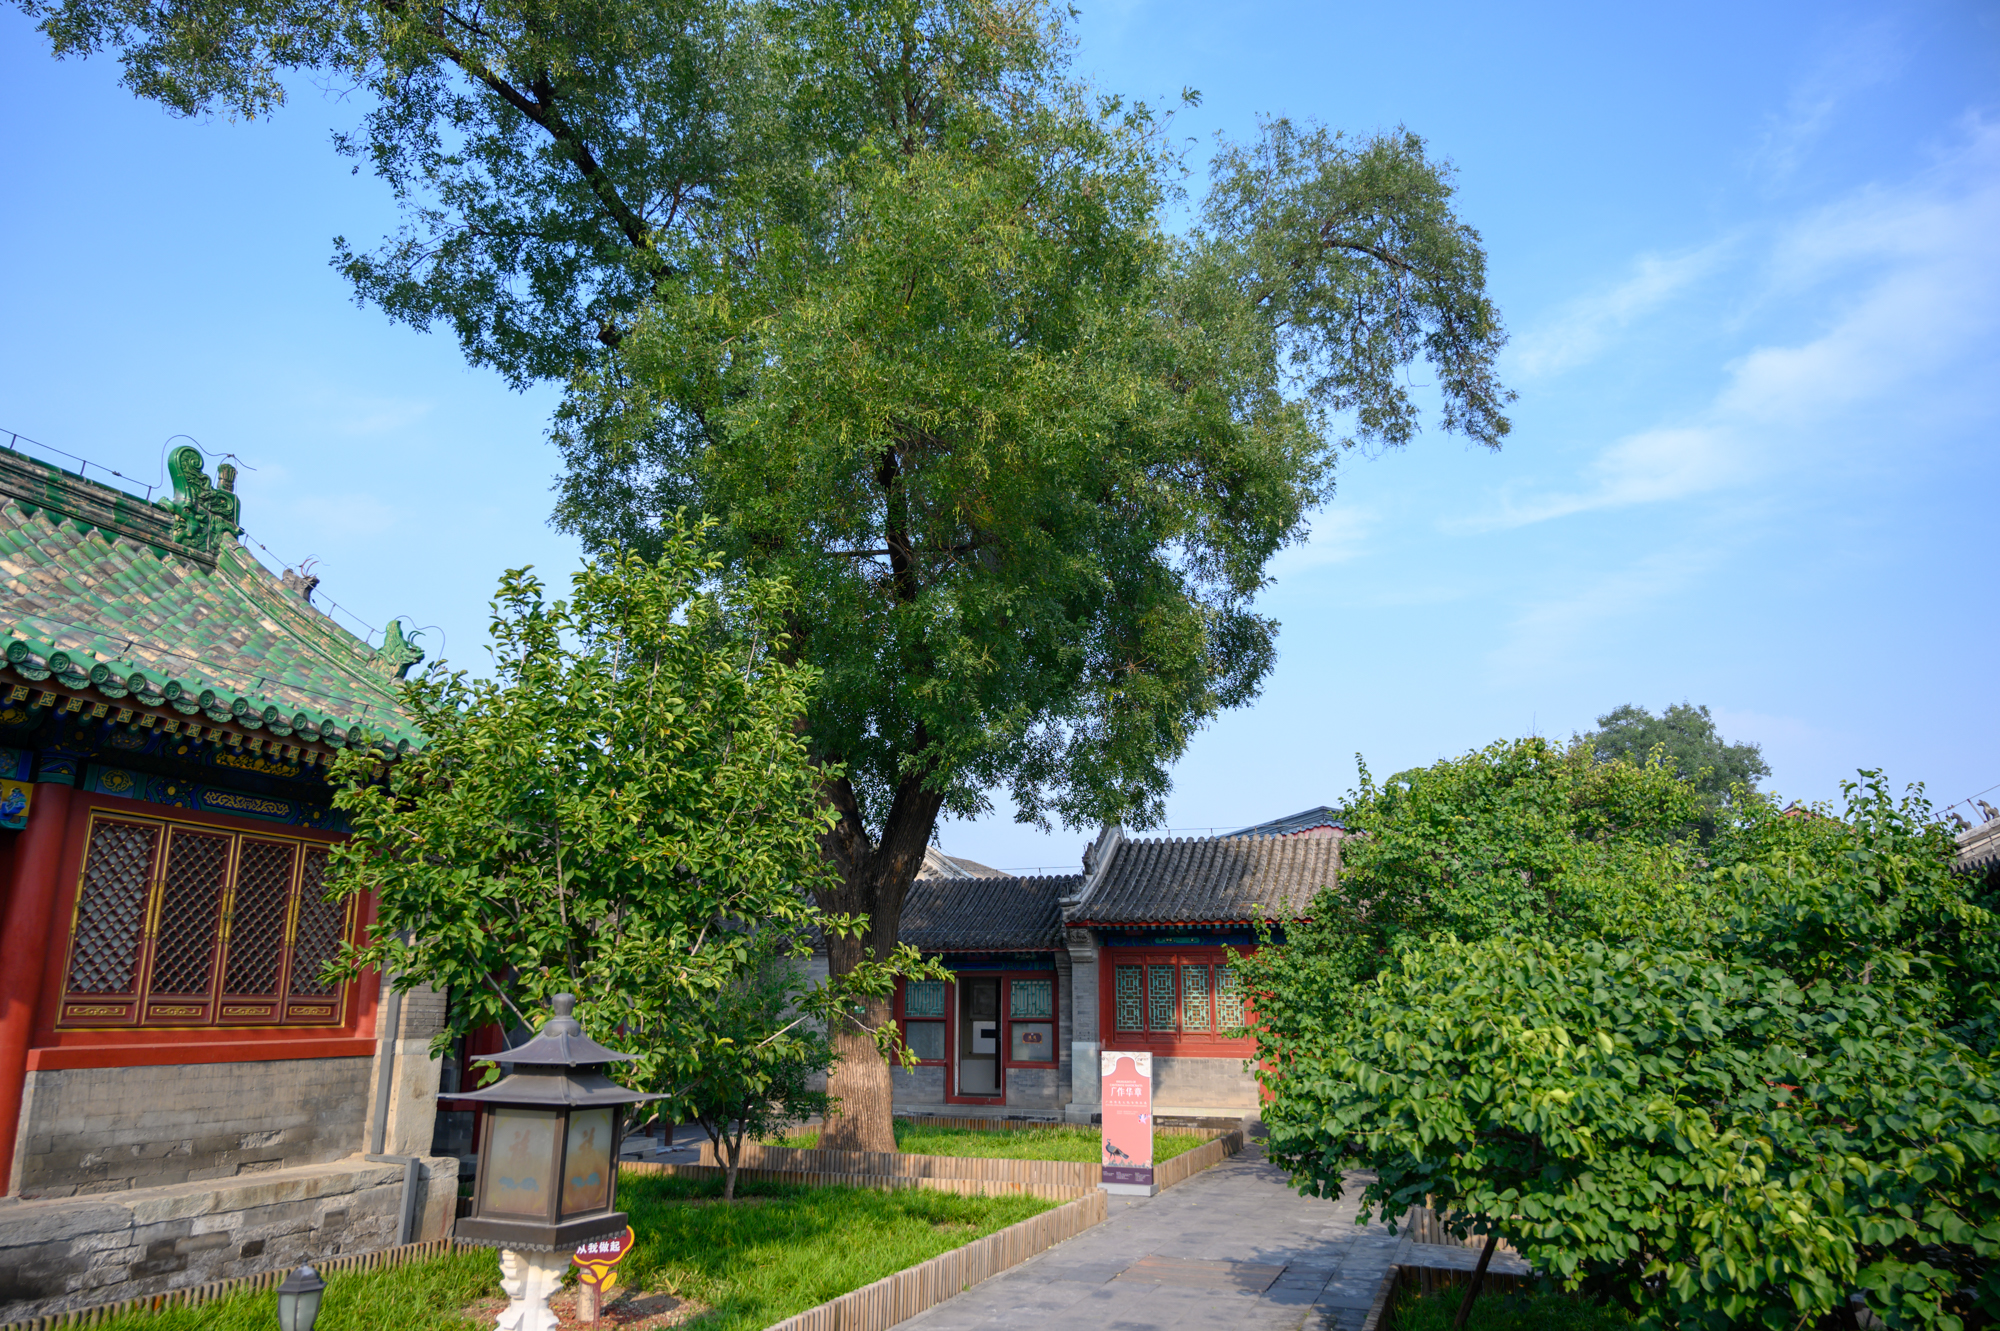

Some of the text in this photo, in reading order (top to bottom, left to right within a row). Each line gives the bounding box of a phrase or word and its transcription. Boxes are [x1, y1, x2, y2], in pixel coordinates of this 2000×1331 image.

[1110, 1086, 1142, 1097] 广作华章
[576, 1240, 621, 1254] 从我做起
